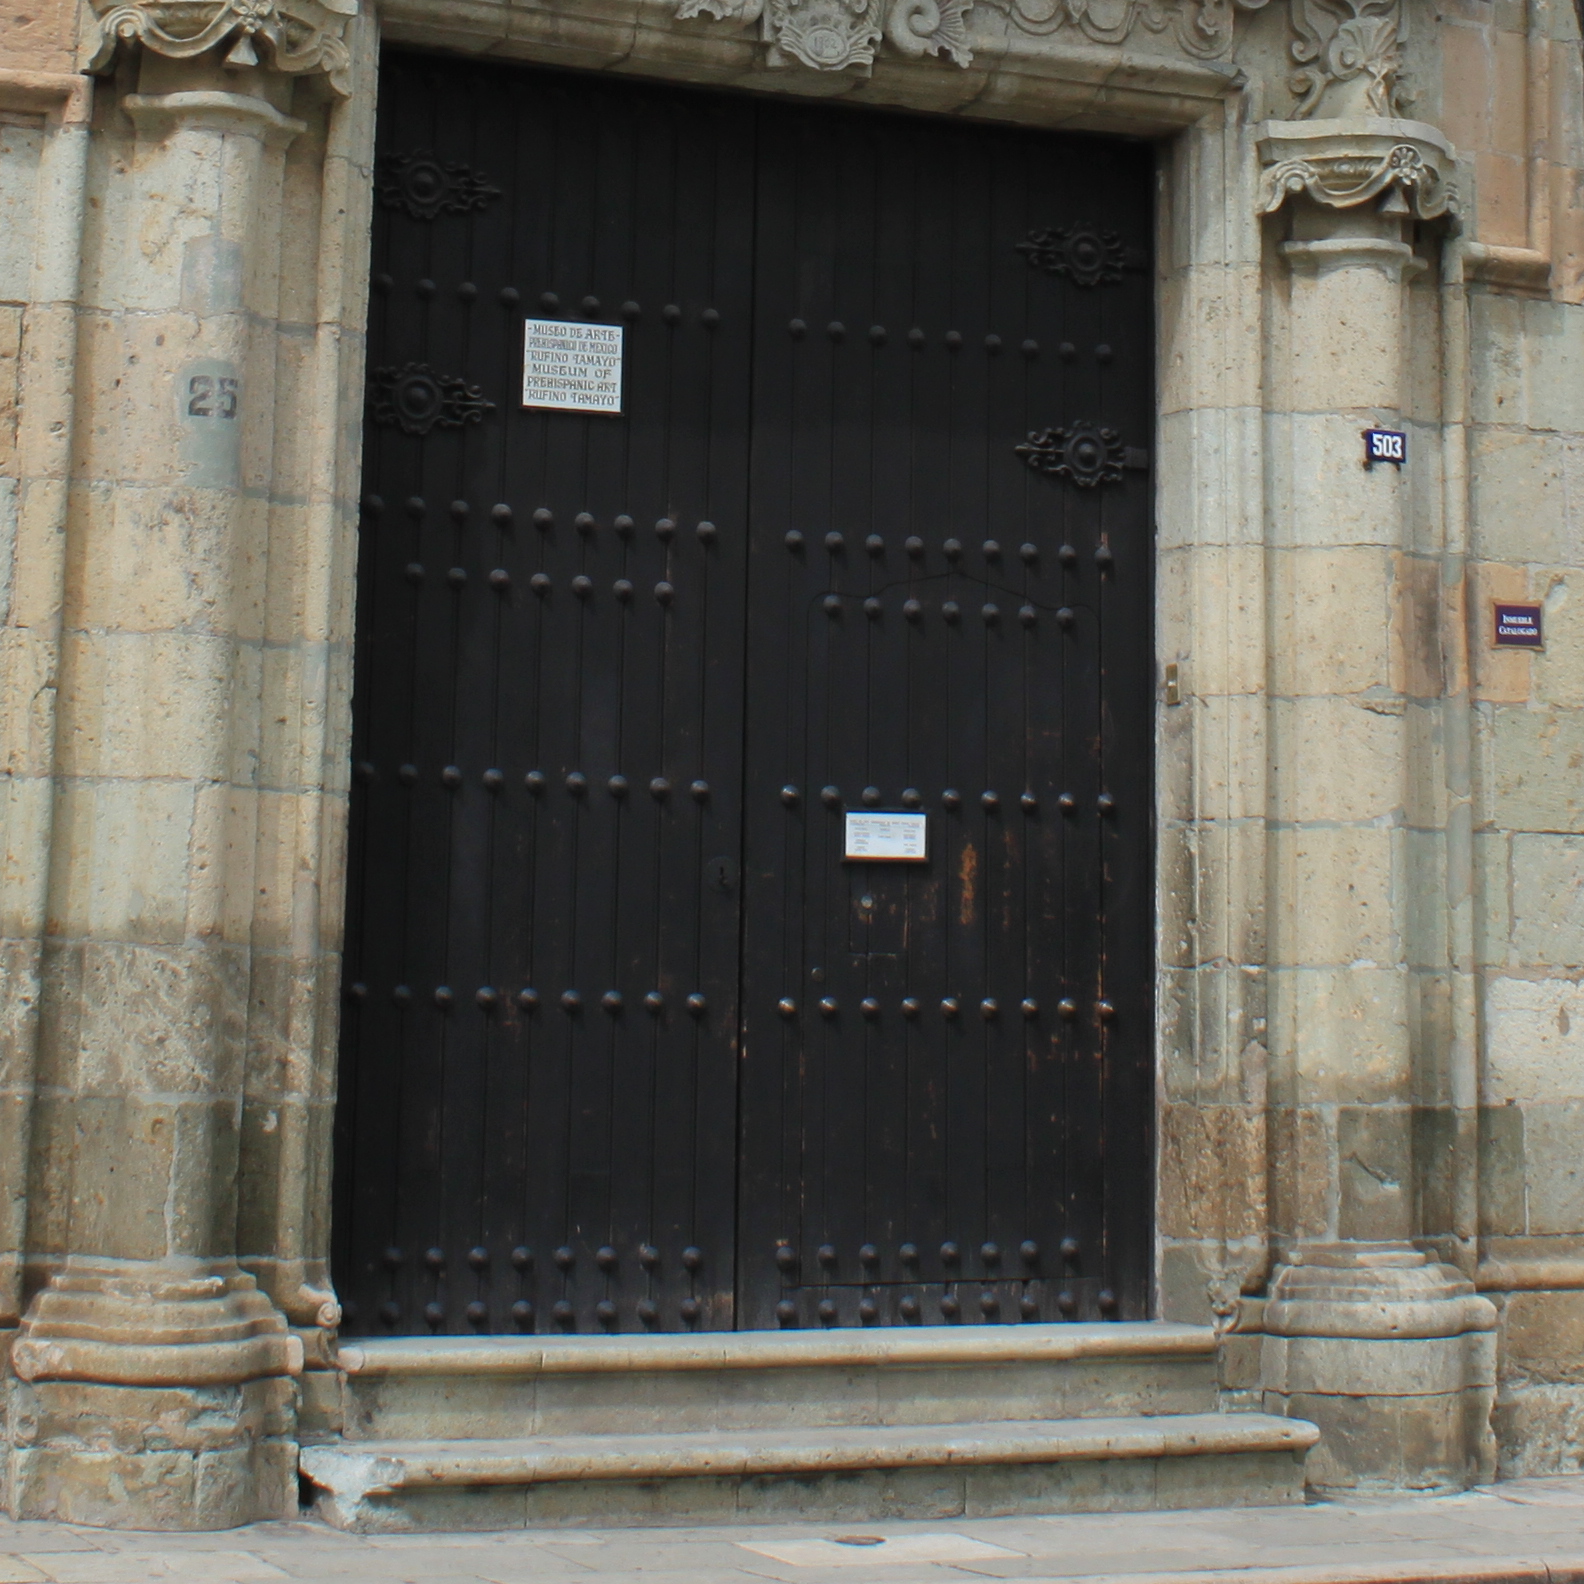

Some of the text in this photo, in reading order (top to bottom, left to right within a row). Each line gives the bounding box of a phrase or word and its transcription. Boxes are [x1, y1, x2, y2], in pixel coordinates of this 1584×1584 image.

[569, 327, 583, 338] DE
[578, 341, 588, 352] DE
[531, 363, 612, 379] MUSEUM OF
[527, 375, 617, 394] PREHISPANIC ART
[187, 374, 239, 419] 25
[1372, 432, 1403, 458] 503
